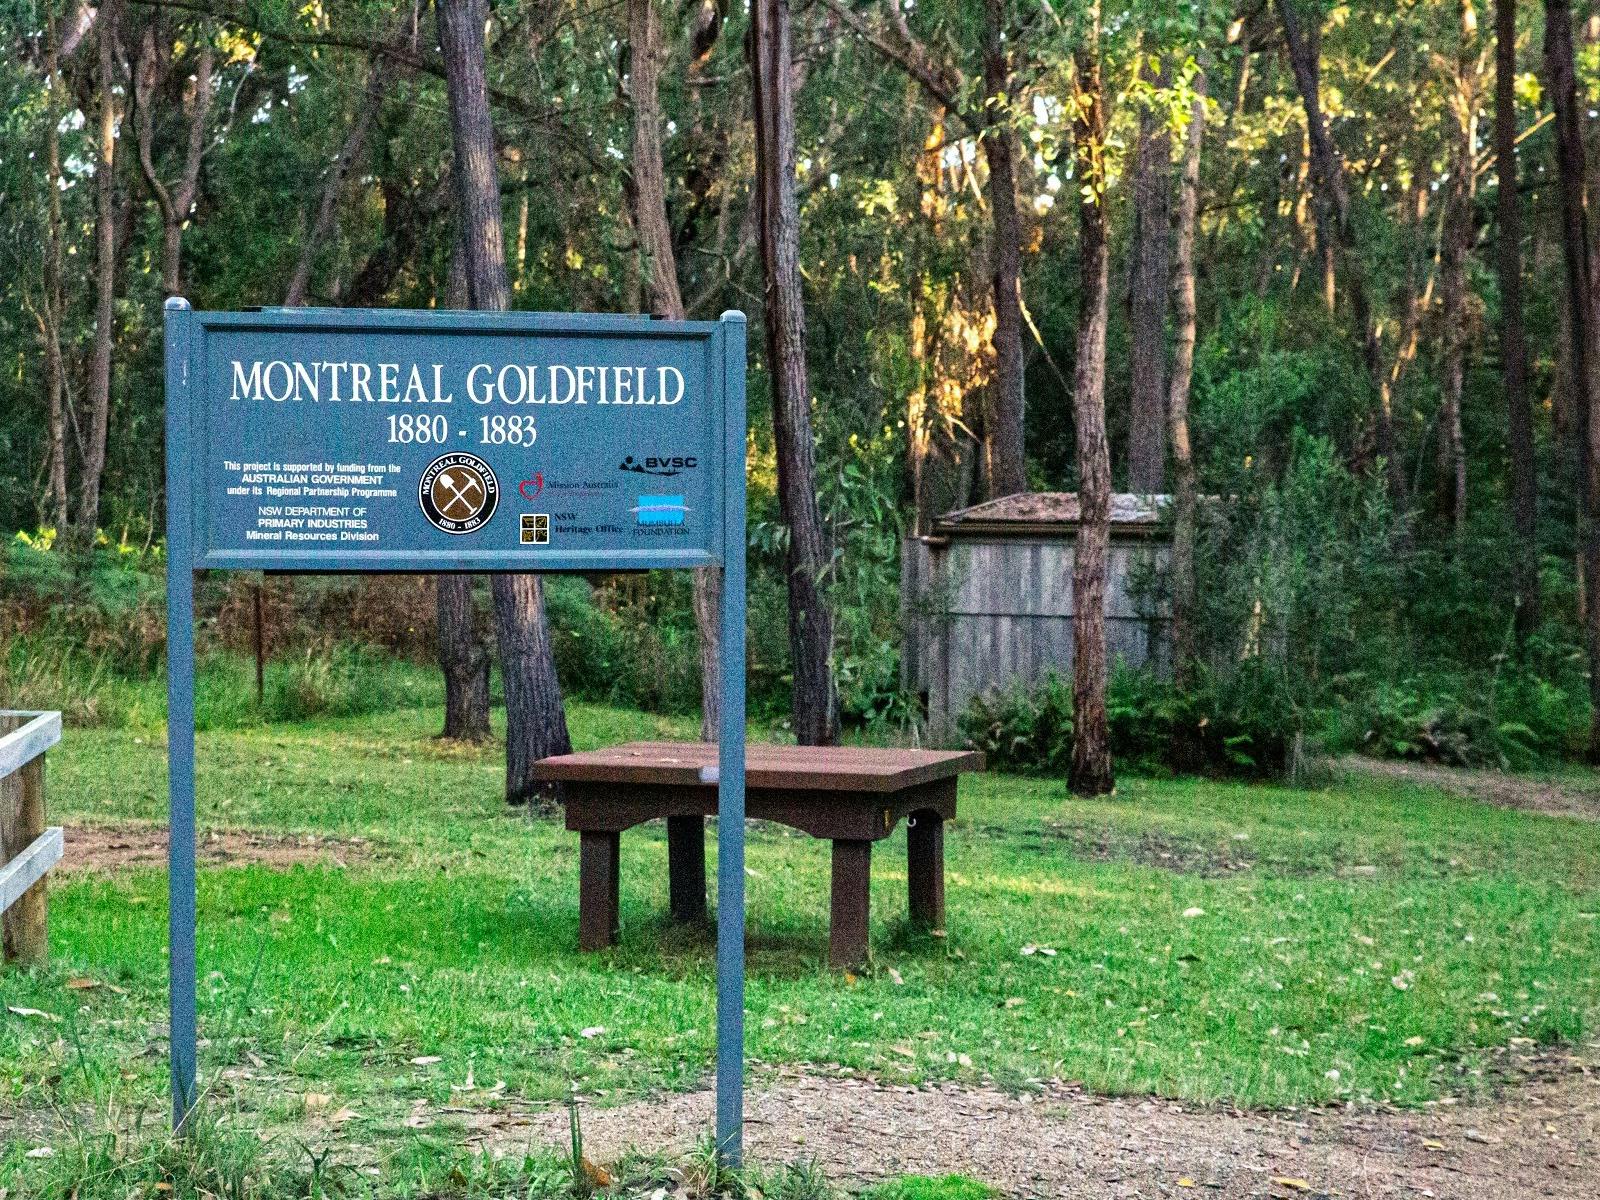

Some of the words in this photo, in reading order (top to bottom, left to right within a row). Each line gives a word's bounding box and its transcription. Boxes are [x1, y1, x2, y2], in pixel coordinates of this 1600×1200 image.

[230, 360, 453, 403] MONTREAL
[466, 363, 685, 405] GOLDFIELD
[386, 414, 448, 443] 1880
[479, 415, 537, 447] 1883
[224, 461, 241, 471] This
[243, 462, 271, 473] project
[273, 462, 280, 471] is
[283, 462, 322, 473] supported
[325, 462, 334, 473] by
[337, 463, 366, 474] funding
[368, 463, 386, 473] from
[388, 463, 401, 473] the
[645, 457, 697, 468] BVSC
[242, 473, 308, 484] AUSTRALIAN
[311, 474, 383, 485] GOVERNMENT
[422, 457, 457, 495] MONTREAL
[458, 456, 495, 494] GOLDFIELD
[547, 481, 580, 489] Mission
[582, 480, 619, 489] Australia
[227, 486, 250, 495] under
[252, 486, 262, 495] its
[266, 486, 301, 497] Regional
[303, 487, 349, 498] Partnership
[351, 487, 397, 498] Programme
[258, 506, 283, 516] NSW
[285, 506, 350, 516] DEPARTMENT
[352, 507, 367, 517] OF
[554, 512, 578, 521] NSW
[258, 519, 304, 528] PRIMARY
[307, 519, 368, 529] INDUSTRIES
[438, 518, 456, 530] 1880
[464, 517, 481, 529] 1883
[554, 525, 593, 534] Heritage
[595, 524, 624, 534] Office
[246, 530, 282, 540] Mineral
[285, 531, 337, 541] Resources
[340, 531, 379, 541] Division
[633, 527, 690, 536] FOUNDATION
